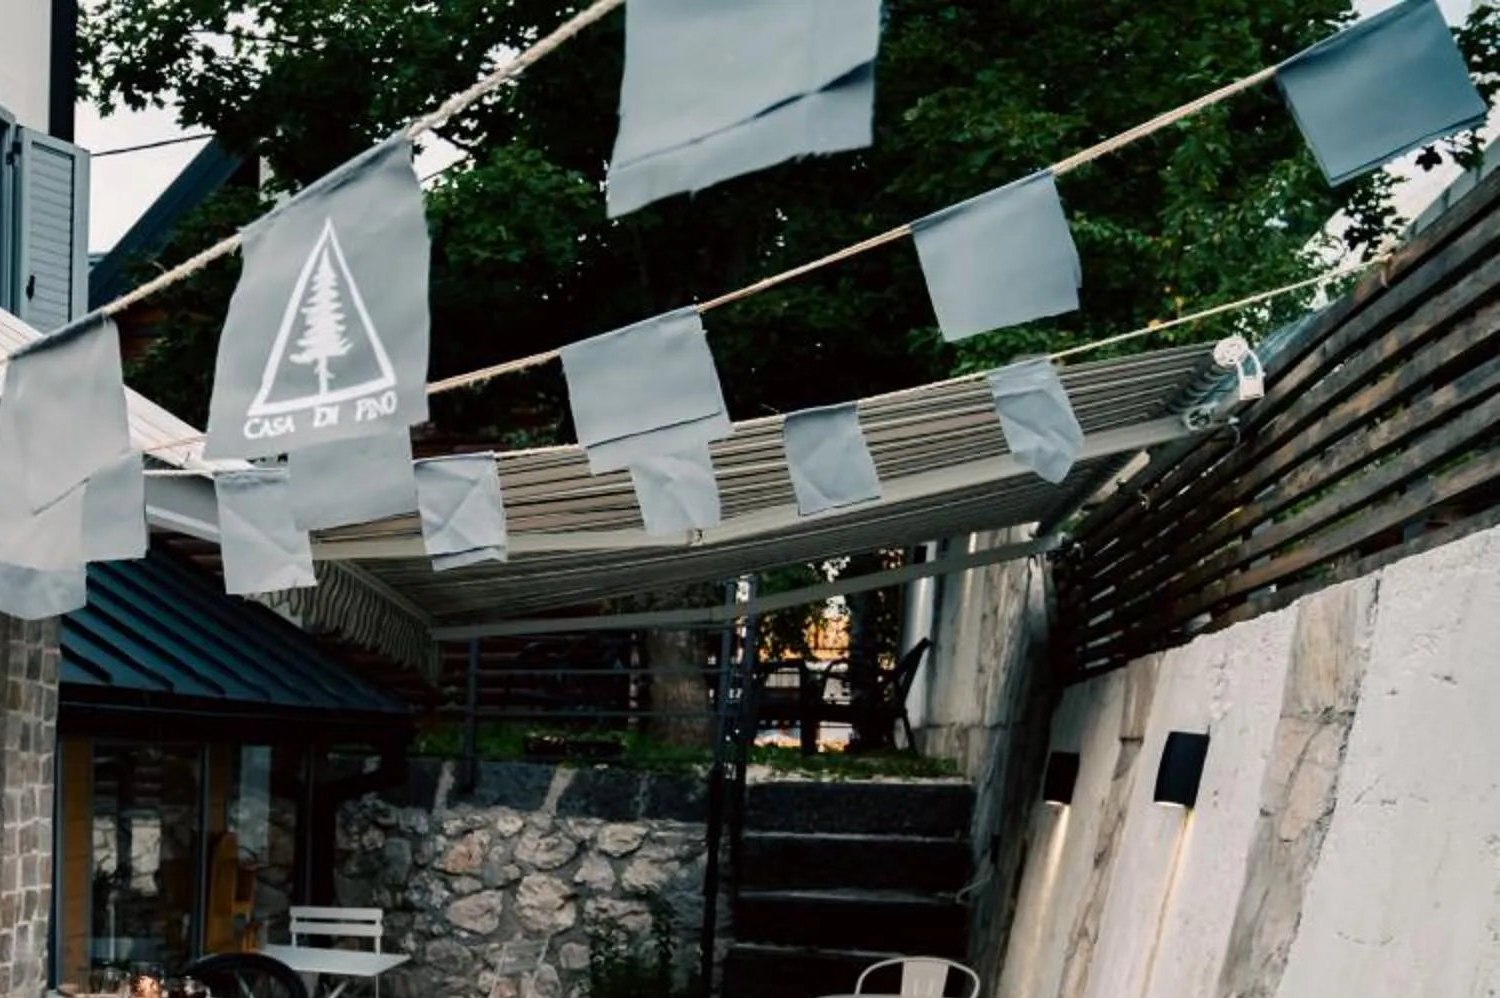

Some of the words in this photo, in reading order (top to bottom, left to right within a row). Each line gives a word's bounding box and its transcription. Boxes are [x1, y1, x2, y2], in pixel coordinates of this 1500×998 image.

[243, 415, 295, 439] CASA
[313, 405, 340, 428] DI
[355, 391, 397, 422] PINO
